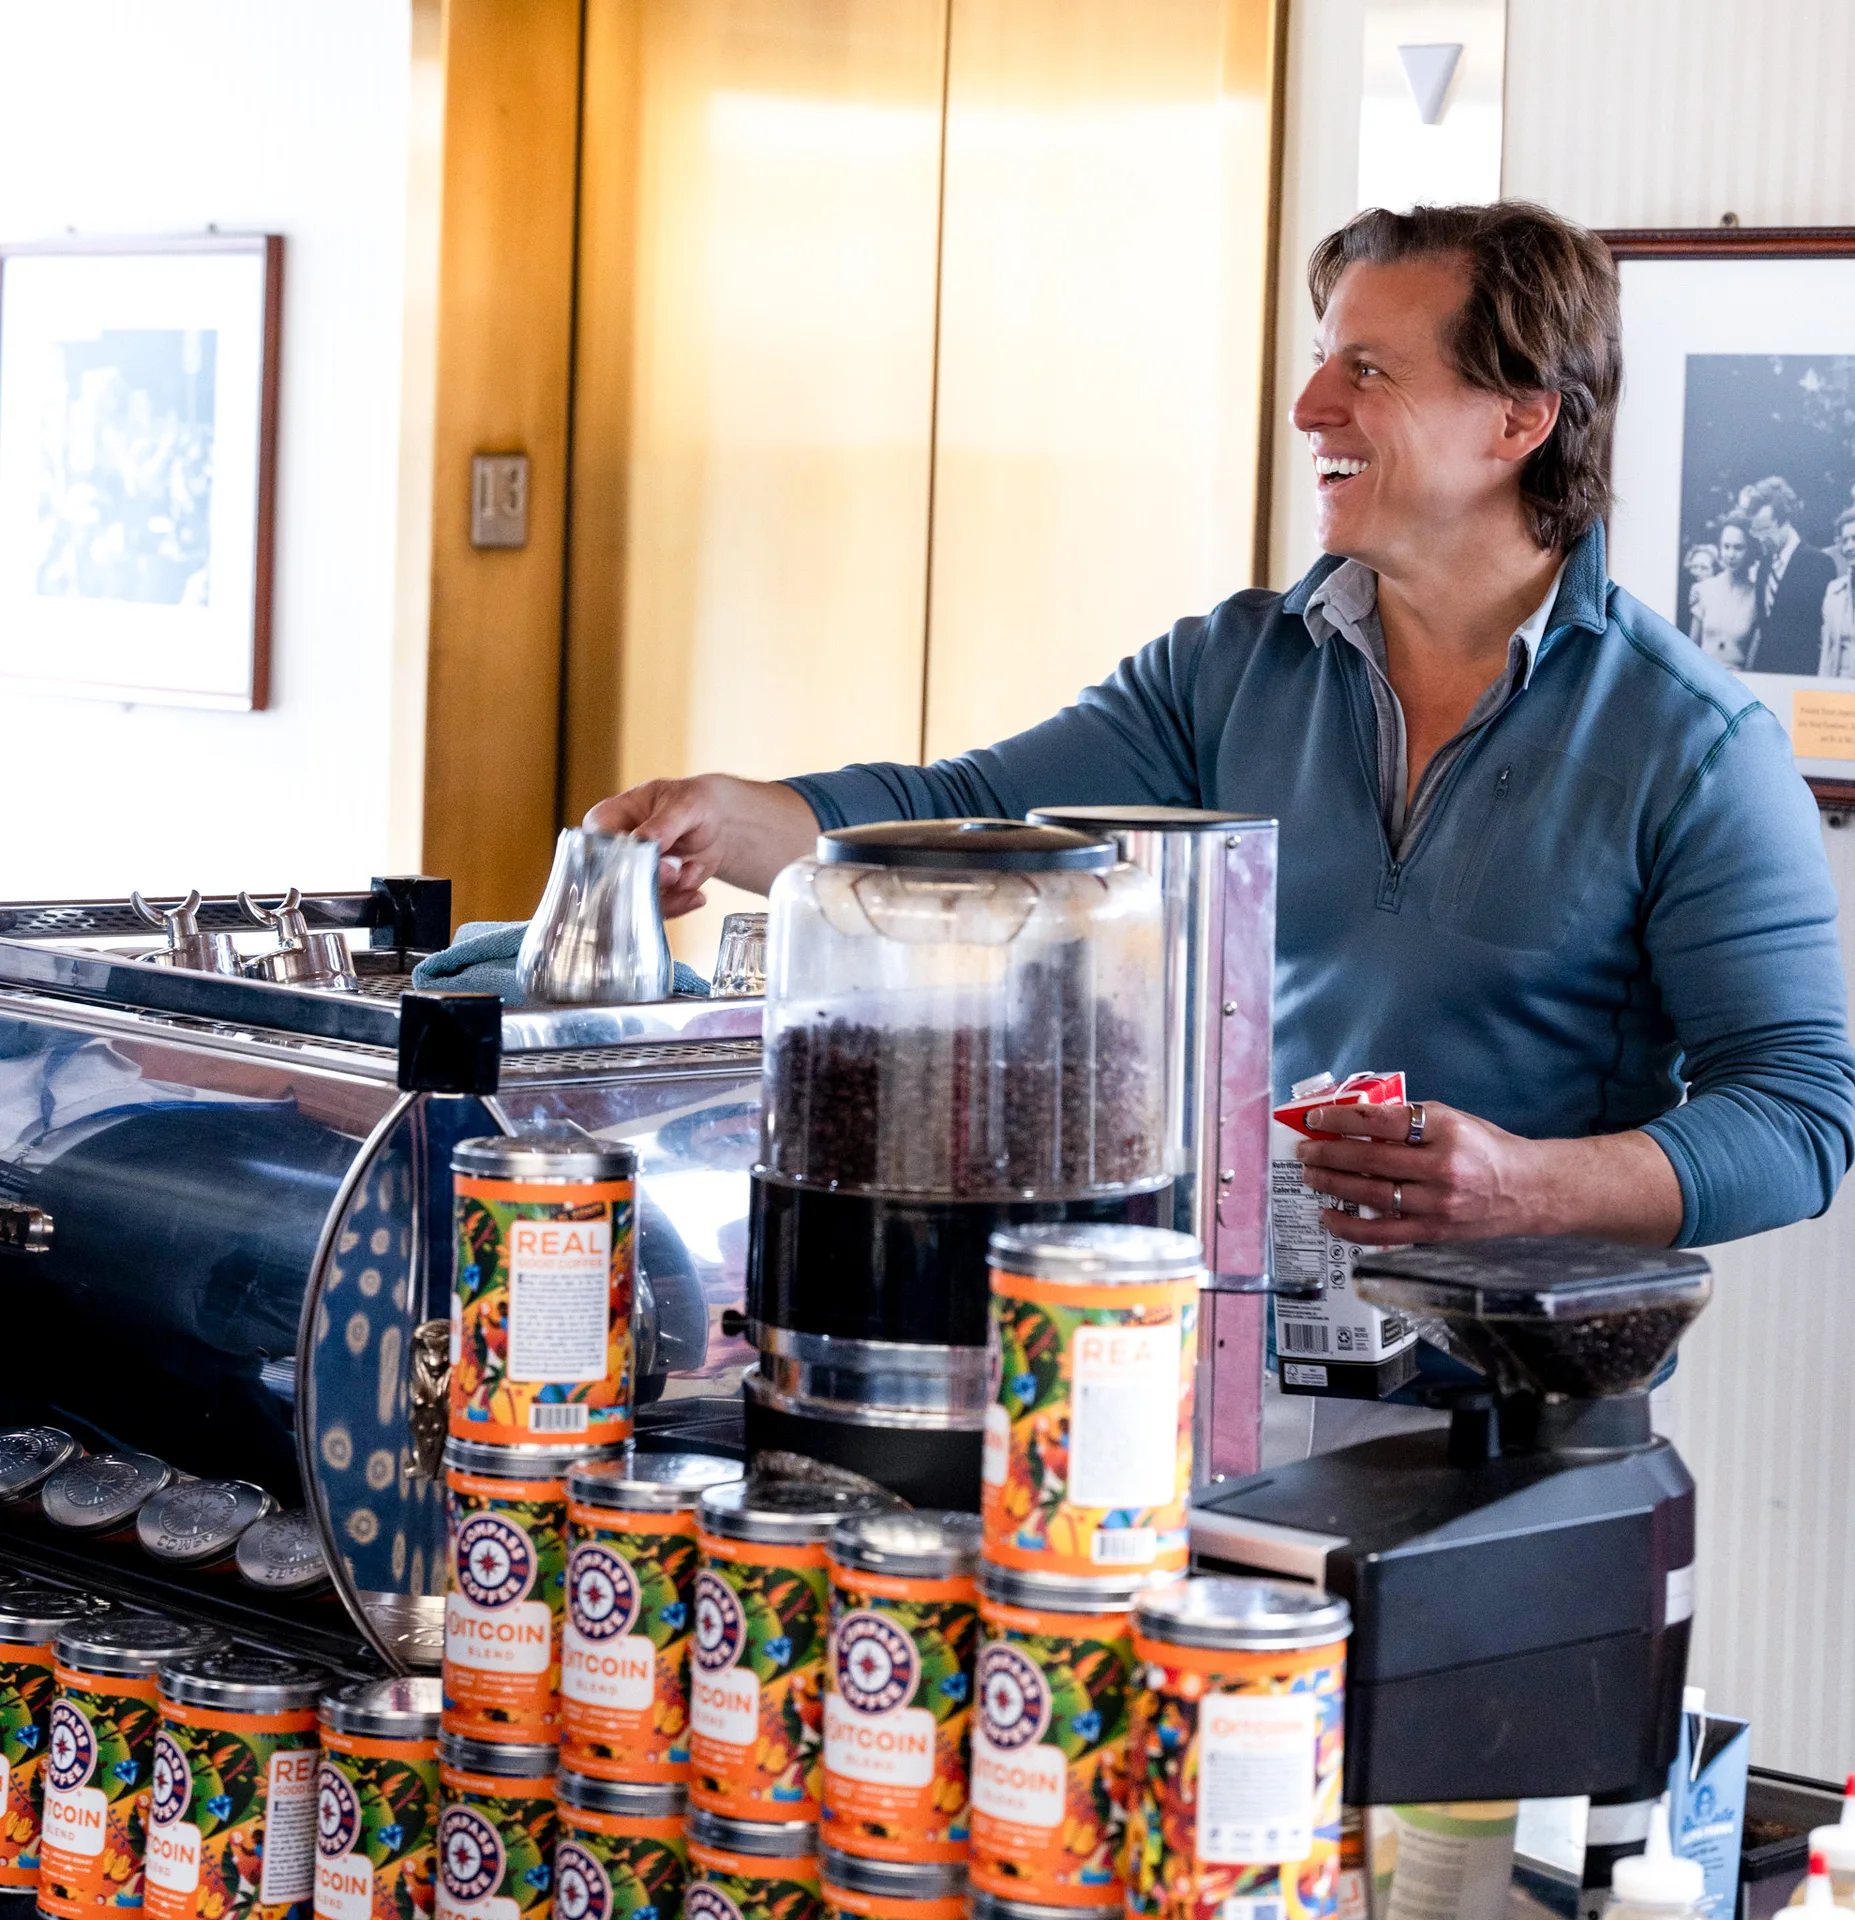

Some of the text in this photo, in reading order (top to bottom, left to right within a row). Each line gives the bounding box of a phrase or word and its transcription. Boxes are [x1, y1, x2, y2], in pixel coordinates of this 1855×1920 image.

[517, 1230, 604, 1256] REAL
[1082, 1337, 1152, 1365] REA
[461, 1522, 526, 1561] COMPASS
[461, 1570, 522, 1605] COFFEE
